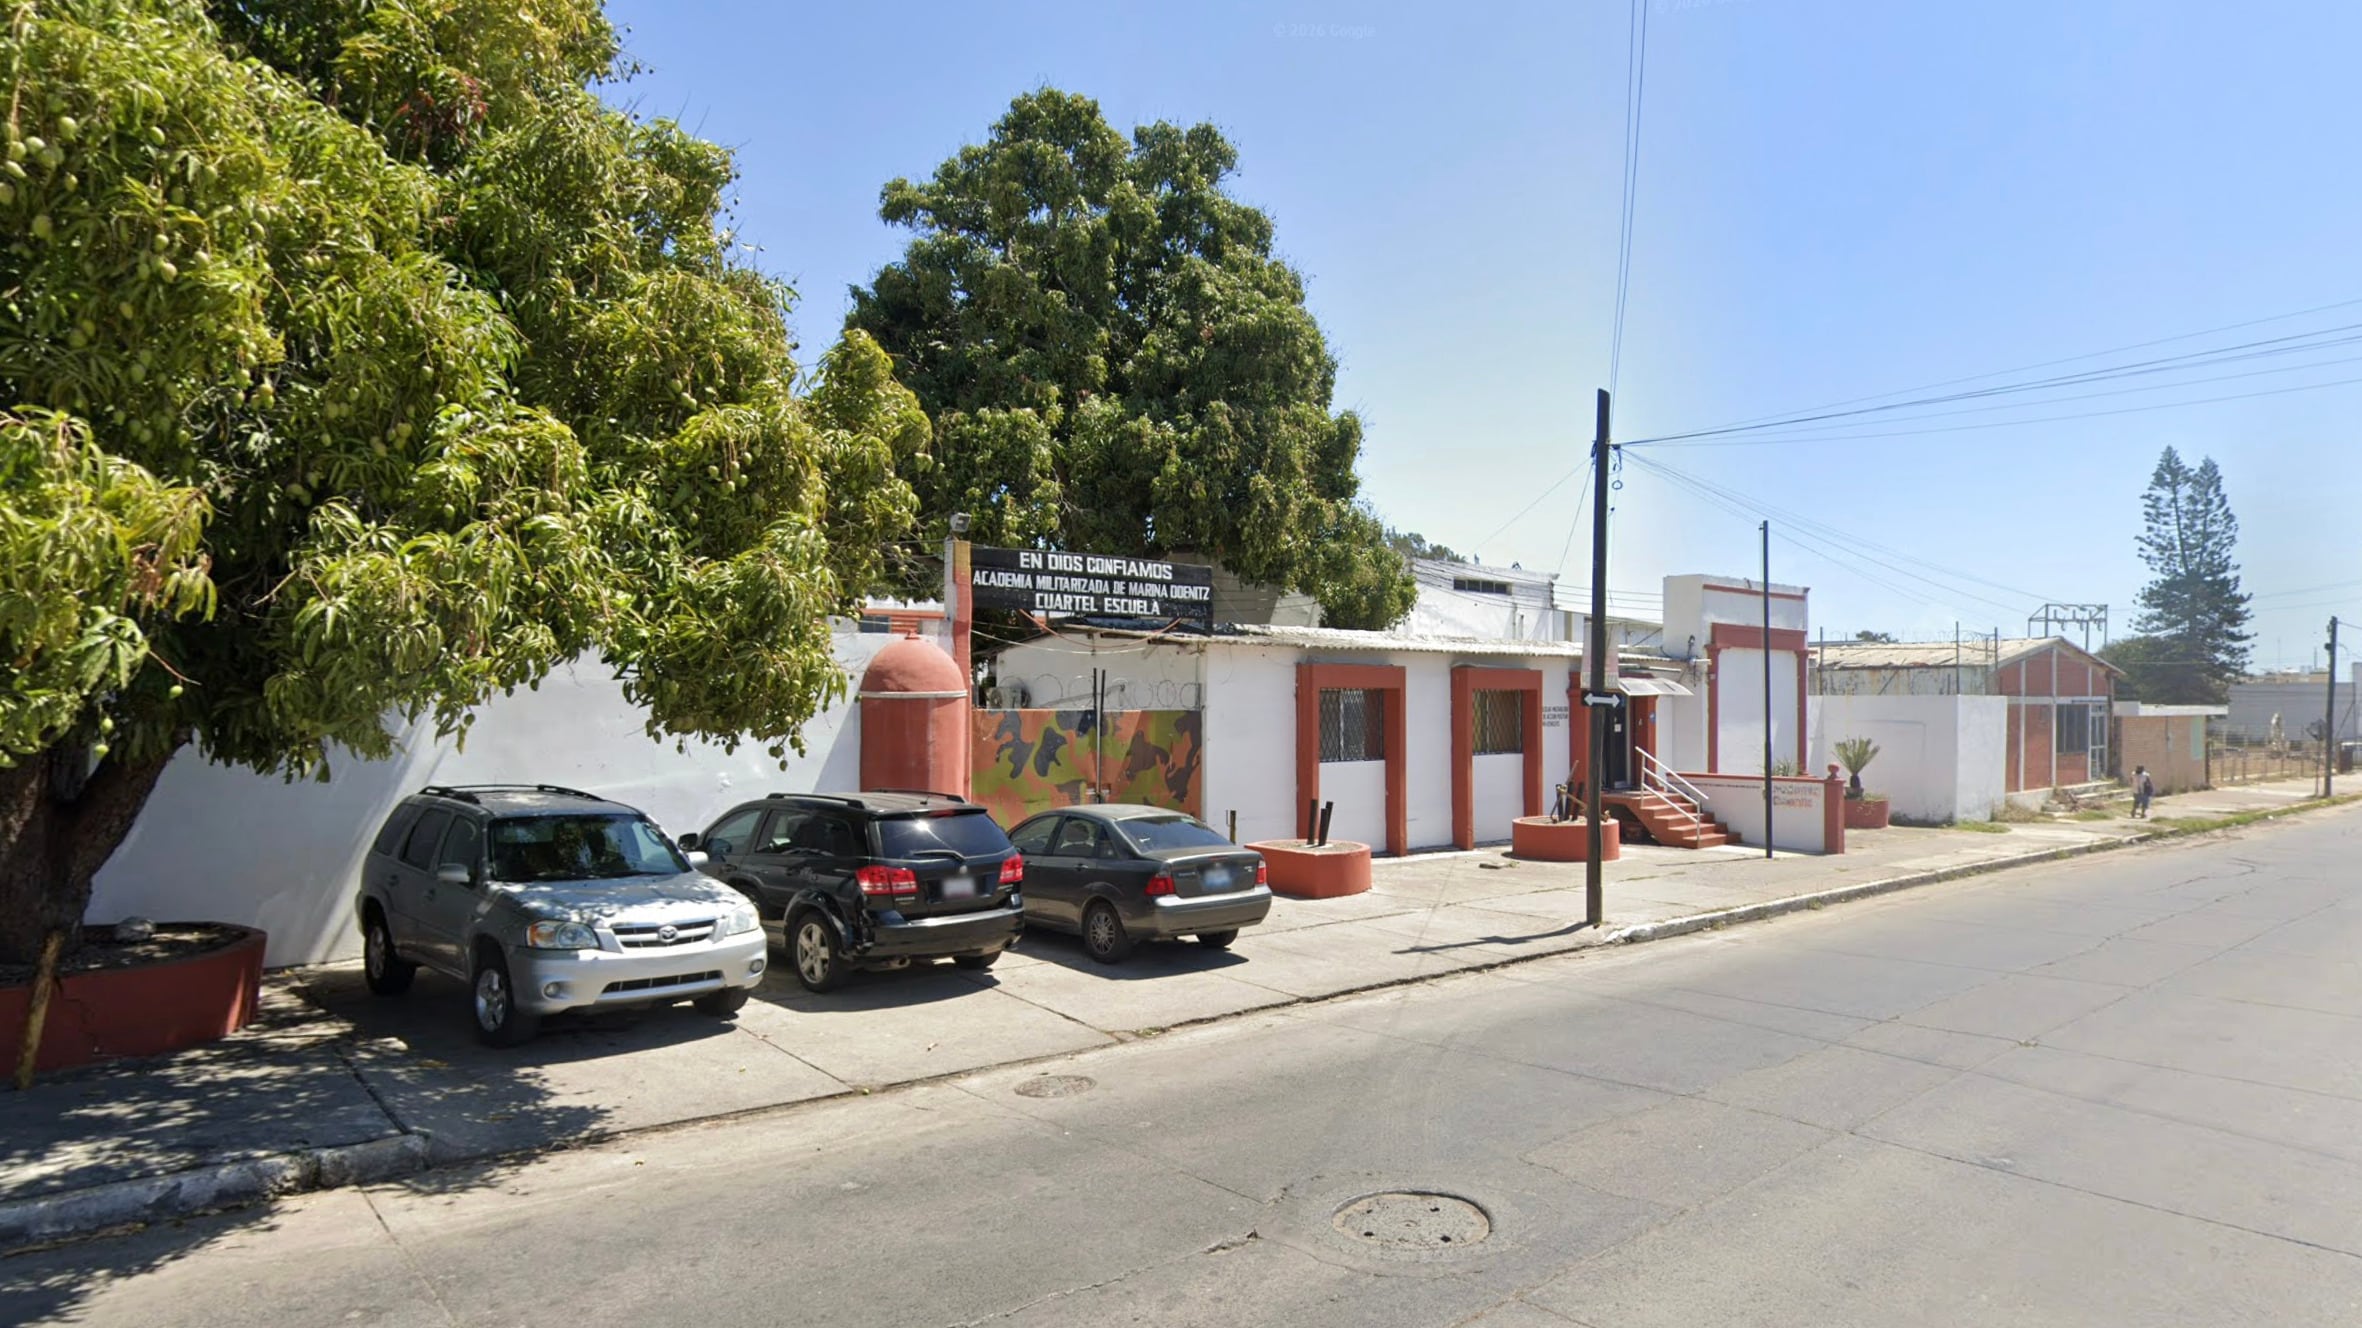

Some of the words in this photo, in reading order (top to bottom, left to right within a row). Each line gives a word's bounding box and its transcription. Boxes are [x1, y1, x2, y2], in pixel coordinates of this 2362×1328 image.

[1019, 552, 1043, 569] EN
[1047, 554, 1083, 572] DIOS
[1086, 558, 1173, 580] CONFIAMOS
[972, 570, 1033, 589] ACADEMIA
[1036, 575, 1110, 594] MILITARIZADA
[1112, 581, 1126, 595] DE
[1128, 581, 1168, 598] MARINA
[1035, 593, 1098, 612] CUARTEL
[1104, 597, 1161, 616] ESCUELA
